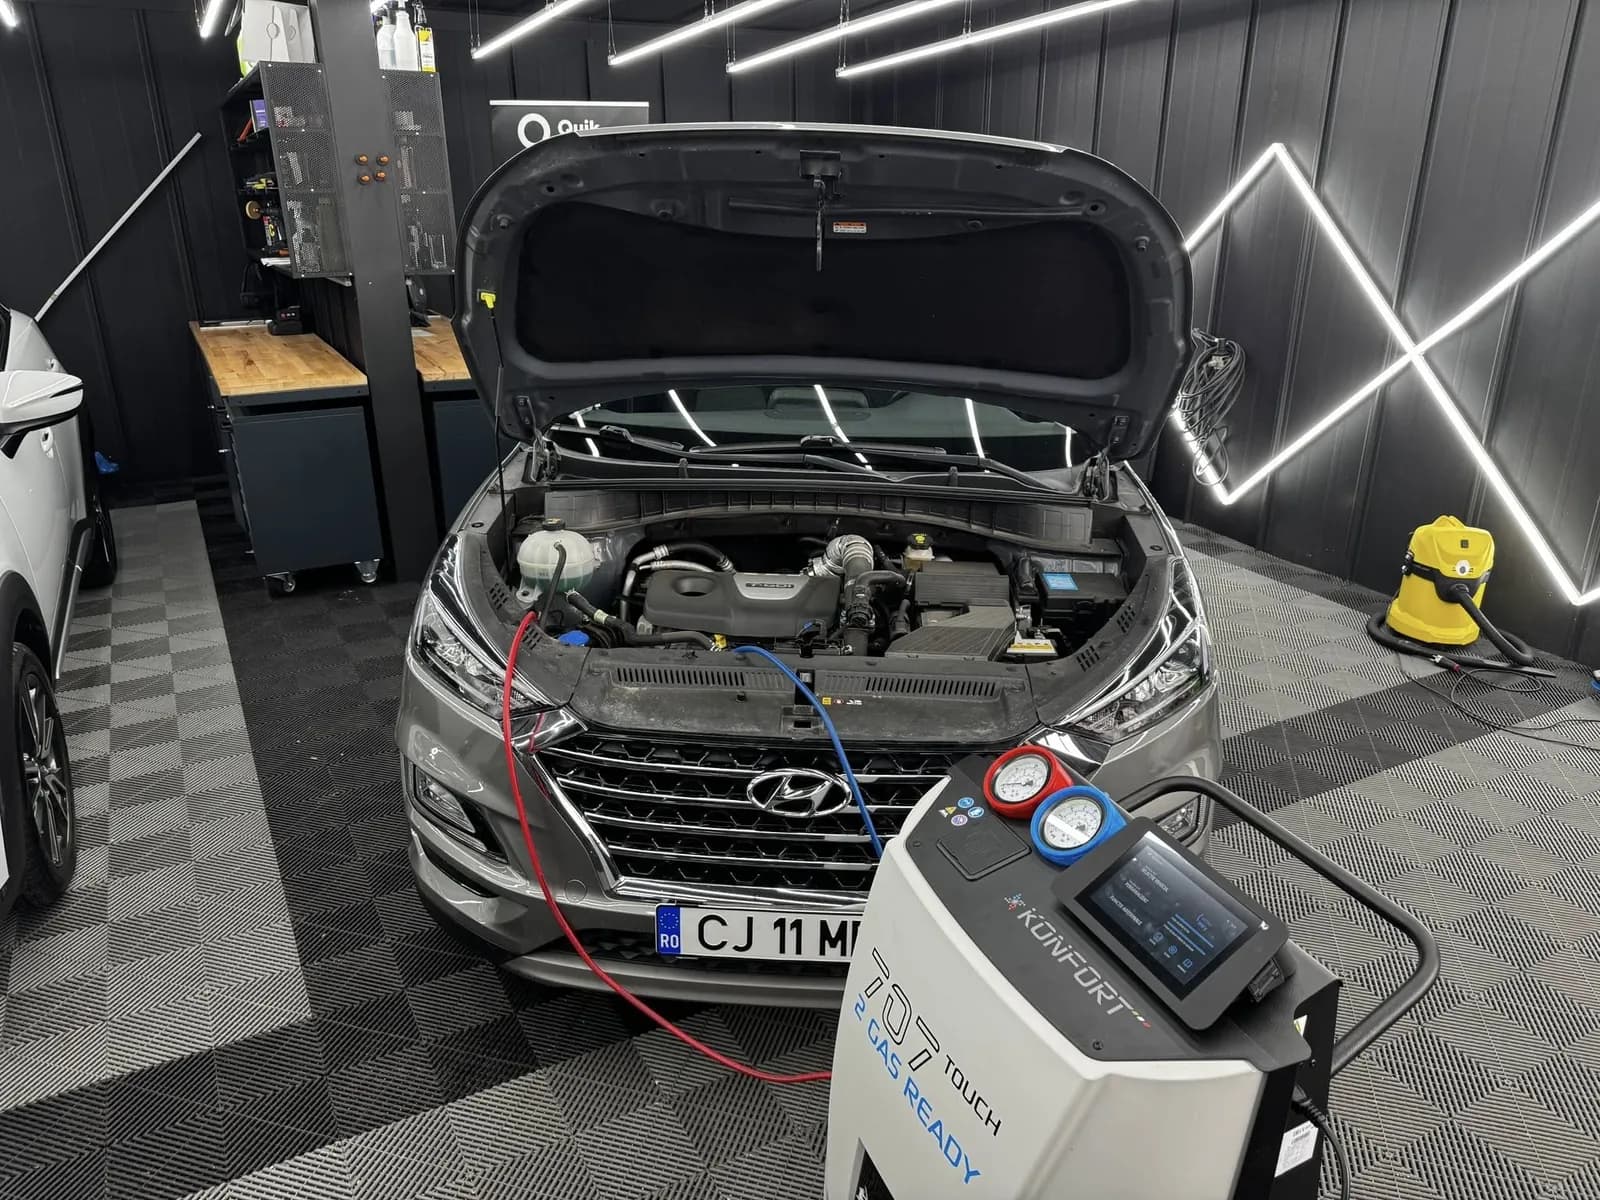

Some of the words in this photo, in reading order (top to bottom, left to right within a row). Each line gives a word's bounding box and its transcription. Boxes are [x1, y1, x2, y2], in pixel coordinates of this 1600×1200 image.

[557, 119, 600, 134] Quik
[659, 934, 680, 949] RO
[698, 914, 754, 952] CJ
[773, 917, 803, 955] 11
[1017, 907, 1134, 1015] KONFORT
[864, 947, 940, 1072] 707
[943, 1054, 1002, 1136] TOUCH
[854, 993, 866, 1021] 2
[867, 1018, 902, 1080] GAS
[903, 1076, 981, 1184] READY
